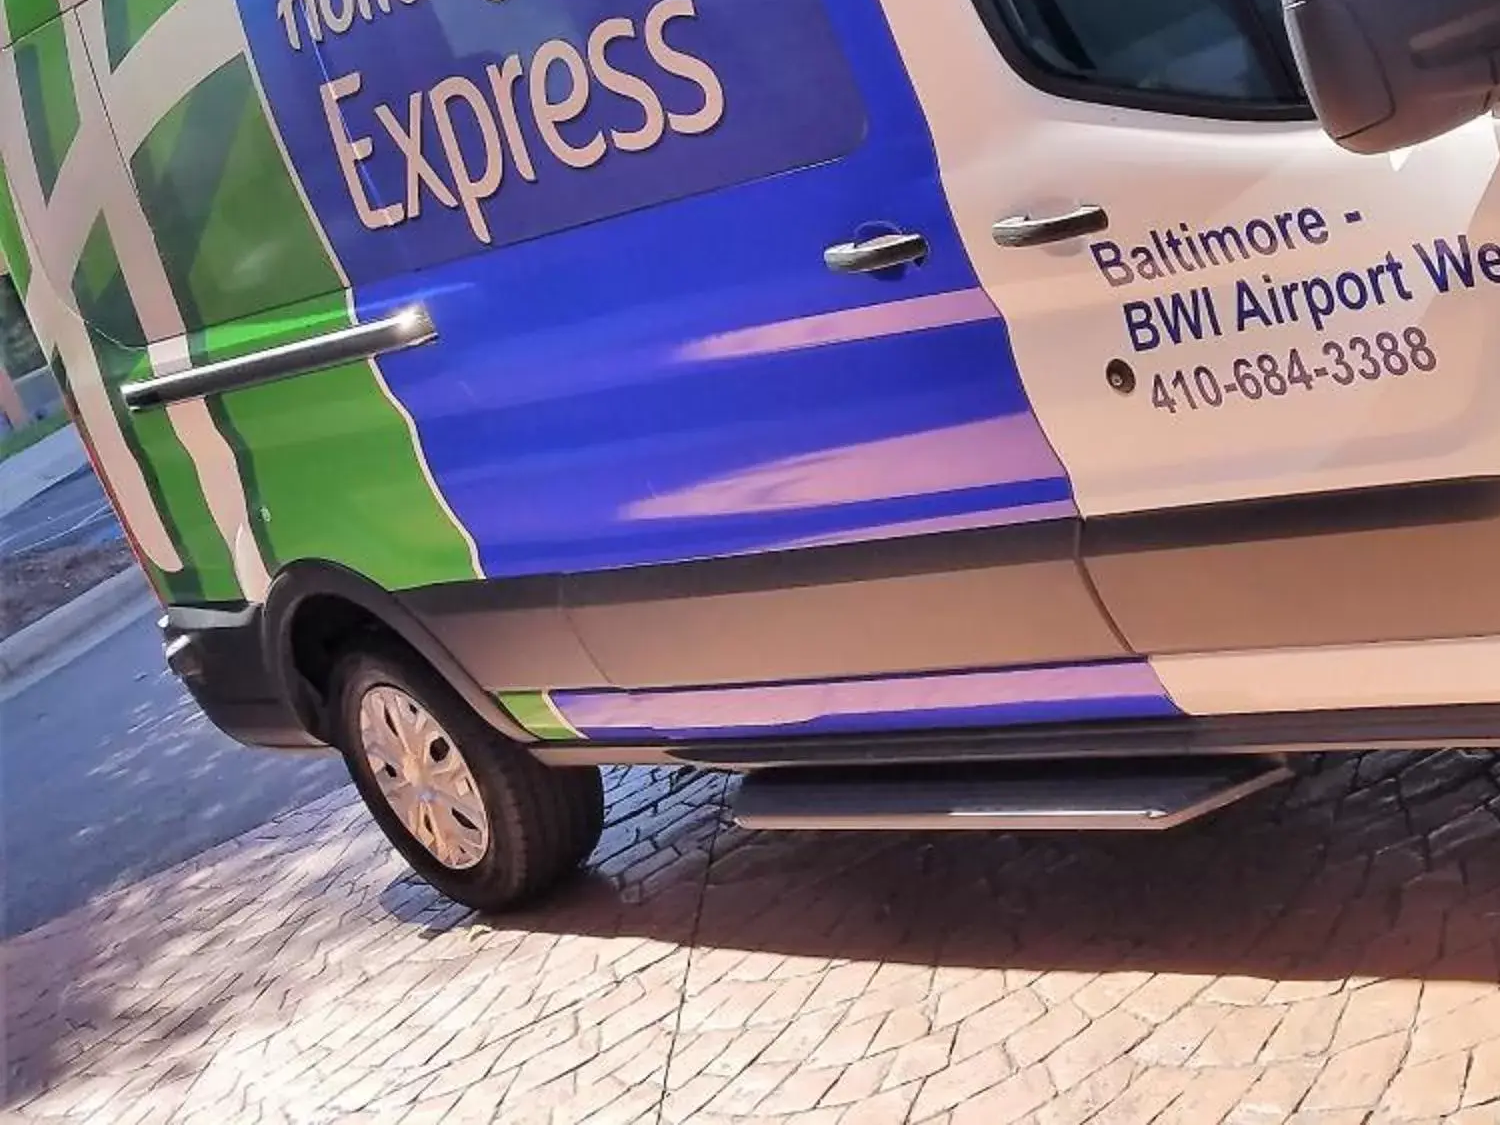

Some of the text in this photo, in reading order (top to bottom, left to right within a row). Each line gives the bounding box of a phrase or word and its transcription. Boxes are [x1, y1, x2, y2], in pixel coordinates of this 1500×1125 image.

[1090, 206, 1331, 288] Baltimore
[1122, 286, 1224, 353] BWI
[1234, 249, 1414, 331] Airport
[1150, 325, 1439, 415] 410-684-3388
